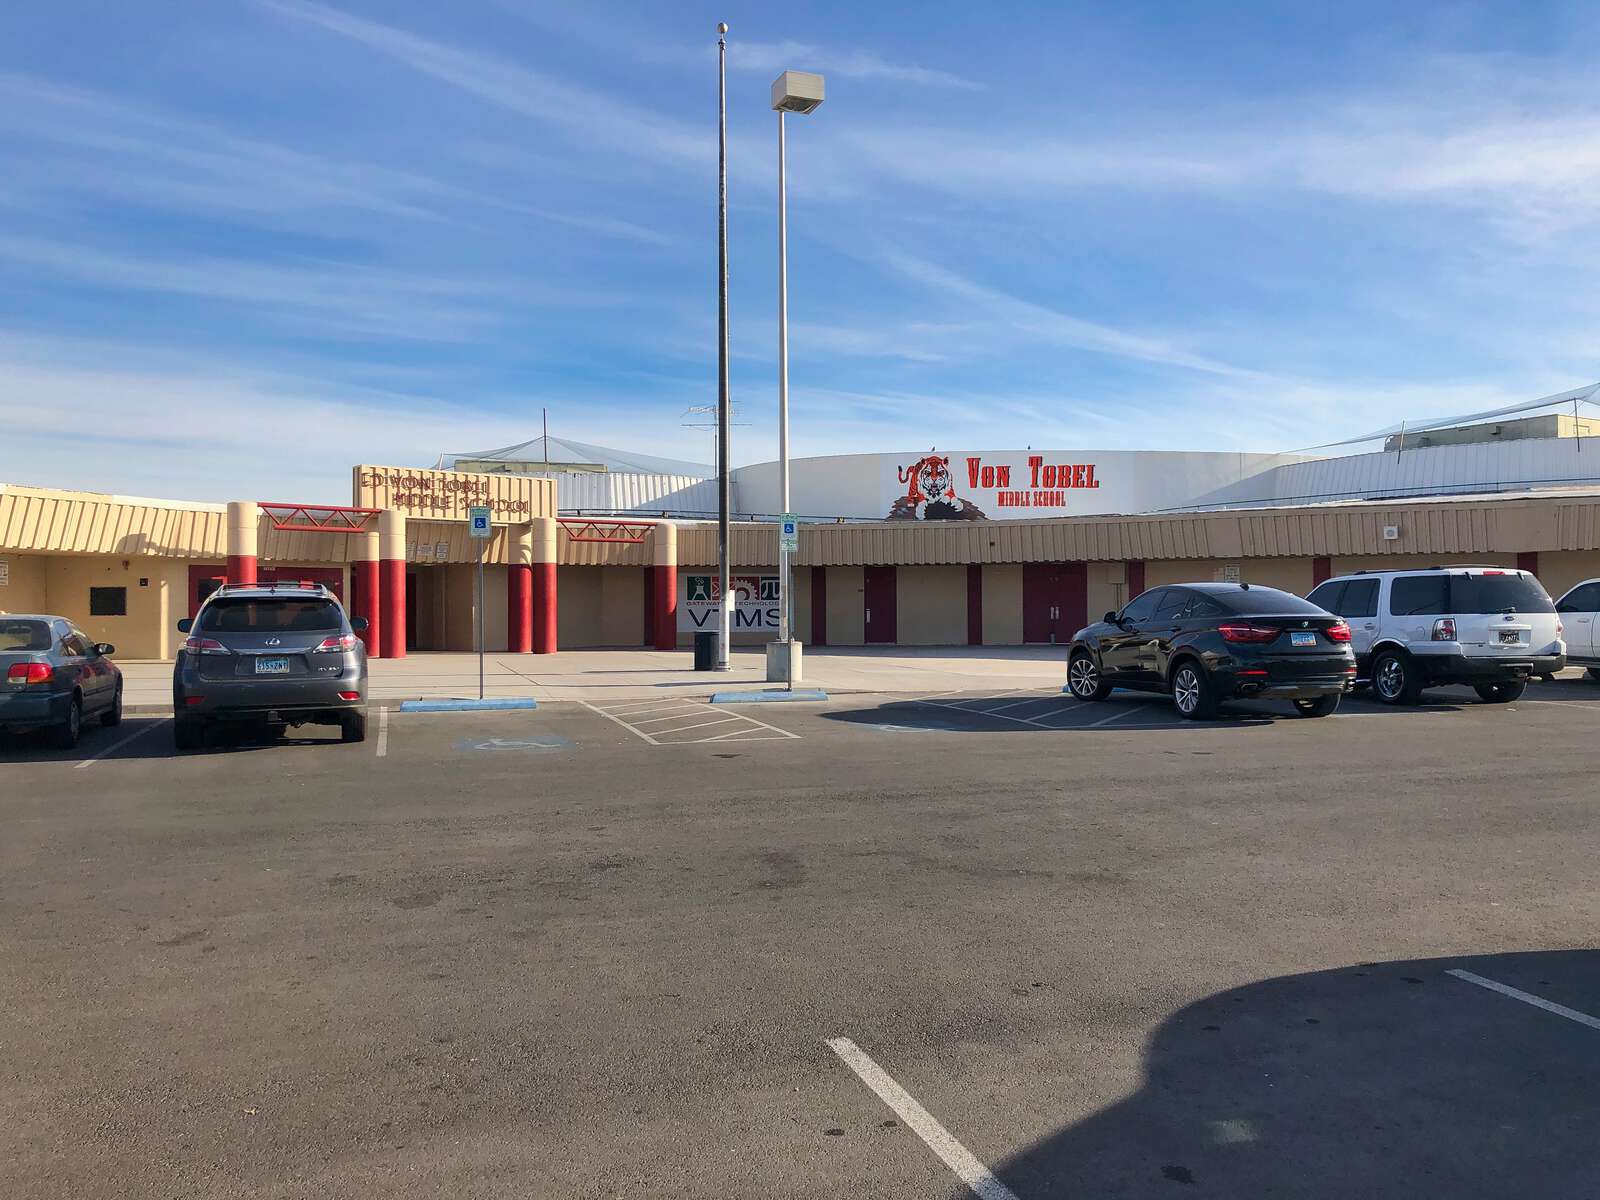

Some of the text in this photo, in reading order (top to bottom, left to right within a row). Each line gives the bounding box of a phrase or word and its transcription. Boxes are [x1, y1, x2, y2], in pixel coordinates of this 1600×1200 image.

[361, 473, 384, 488] ED
[998, 491, 1066, 507] MIDDLE SCHOOL
